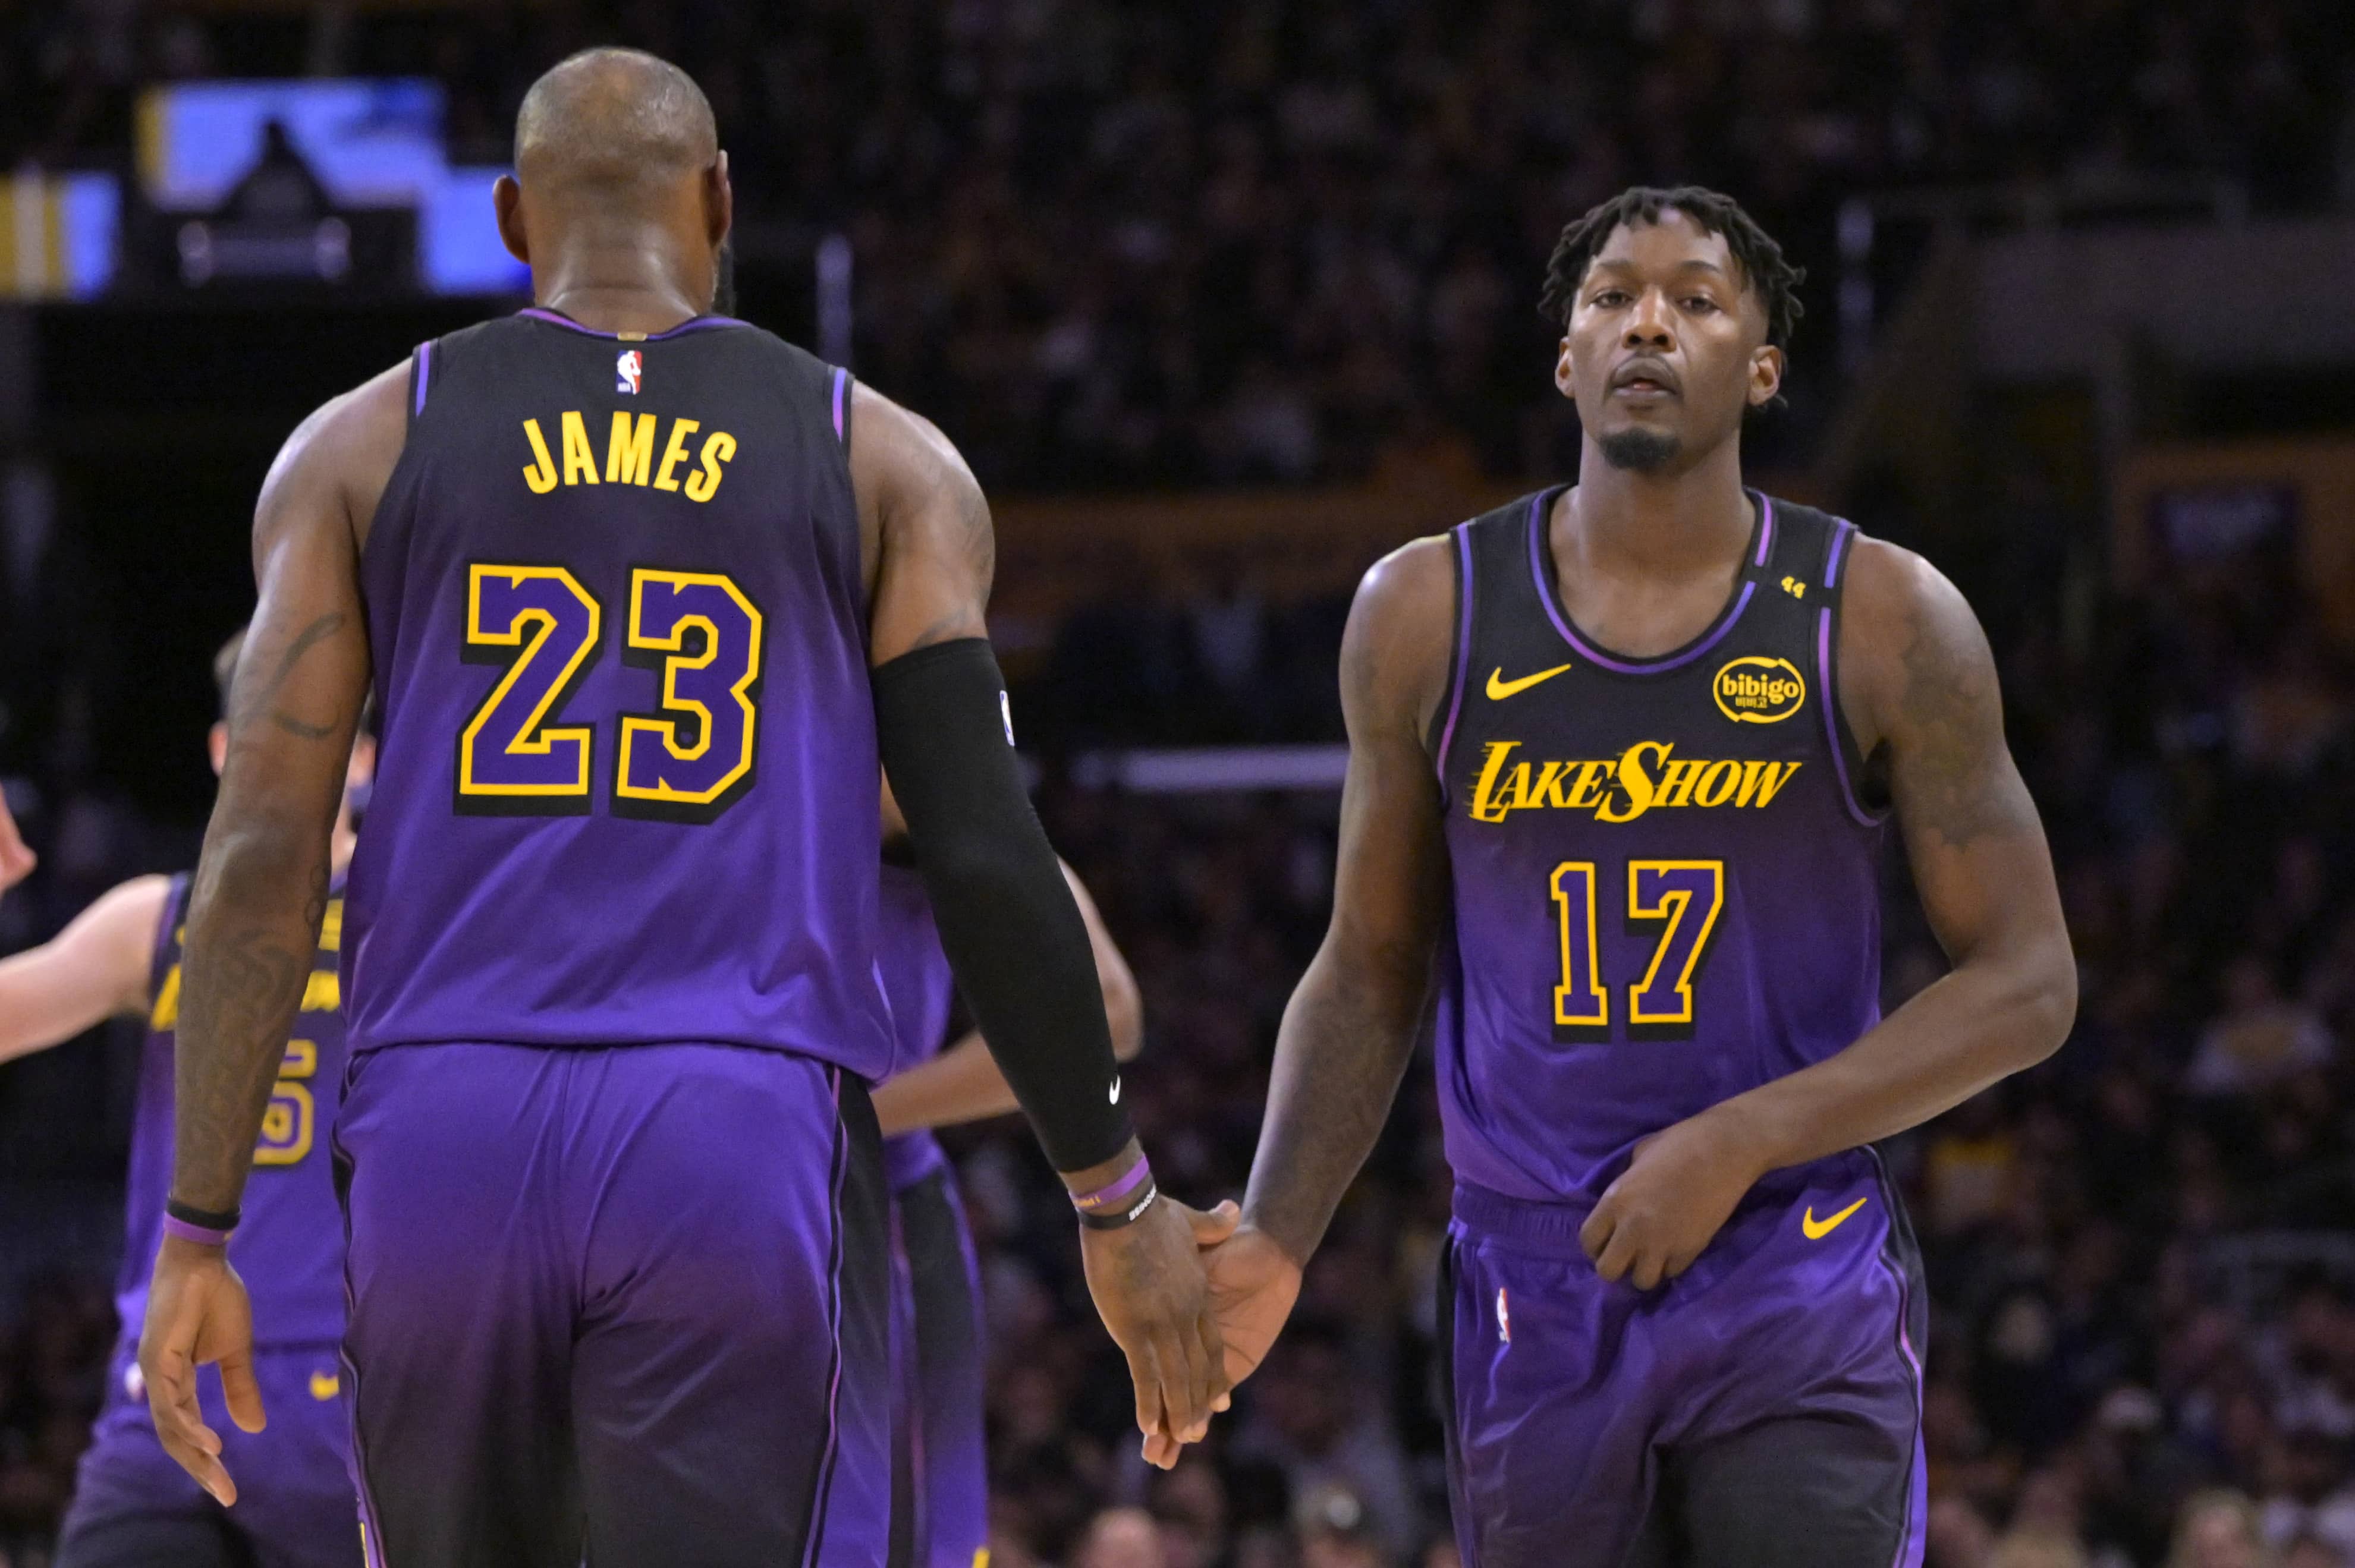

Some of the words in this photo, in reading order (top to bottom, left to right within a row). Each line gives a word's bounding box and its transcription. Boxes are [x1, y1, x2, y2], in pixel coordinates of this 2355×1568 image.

[523, 411, 737, 502] JAMES
[1782, 577, 1806, 598] 44
[460, 563, 763, 804] 23
[1722, 673, 1799, 704] bibigo
[1551, 860, 1724, 1026] 17
